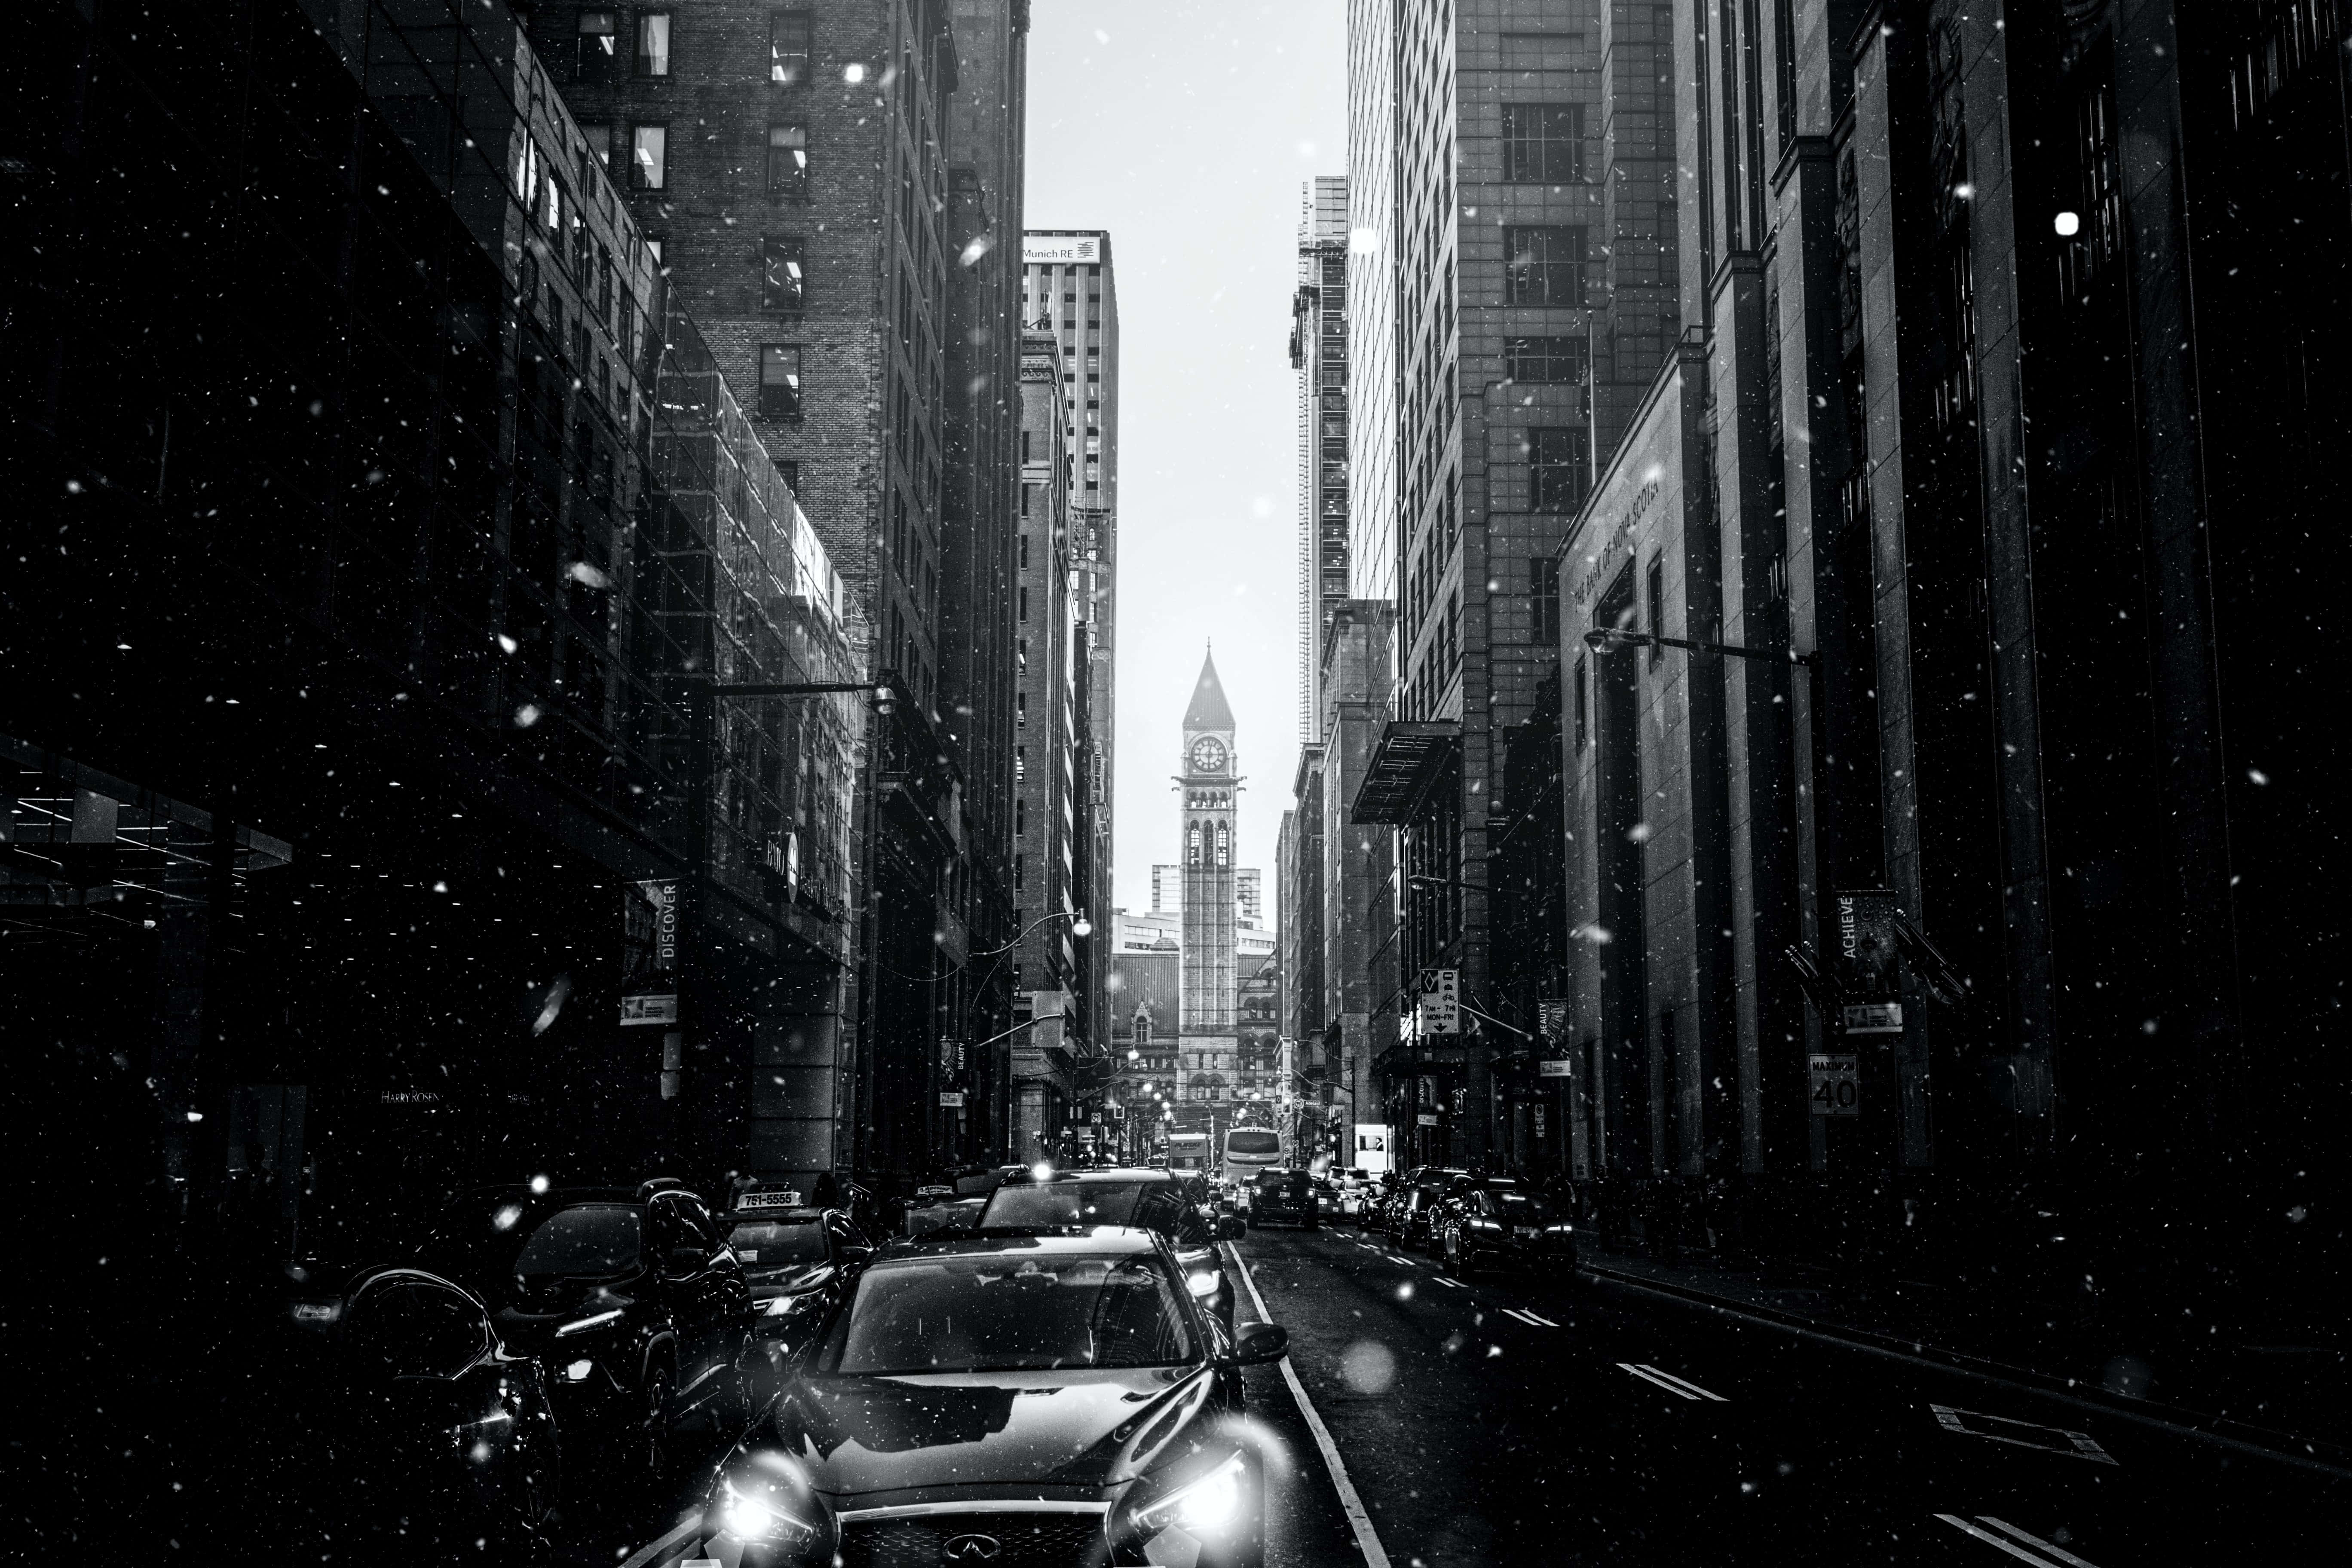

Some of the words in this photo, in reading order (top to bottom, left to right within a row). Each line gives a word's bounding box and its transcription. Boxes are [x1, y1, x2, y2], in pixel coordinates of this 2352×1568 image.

[1023, 250, 1058, 258] Munich
[1060, 250, 1073, 258] RE
[1574, 582, 1584, 613] THE
[1587, 557, 1601, 597] BANK
[1603, 542, 1610, 570] OF
[1613, 511, 1630, 557] NOVA
[1633, 481, 1658, 526] SCOTIA
[662, 885, 676, 958] DISCOVER
[1840, 897, 1856, 958] ACHIEVE
[1539, 1003, 1547, 1034] BEAUTY
[1813, 1062, 1854, 1071] MAXIMUM
[381, 1090, 410, 1103] HARRY
[411, 1090, 441, 1103] ROSEN
[1813, 1080, 1856, 1108] 40
[746, 1193, 792, 1206] 751-5555
